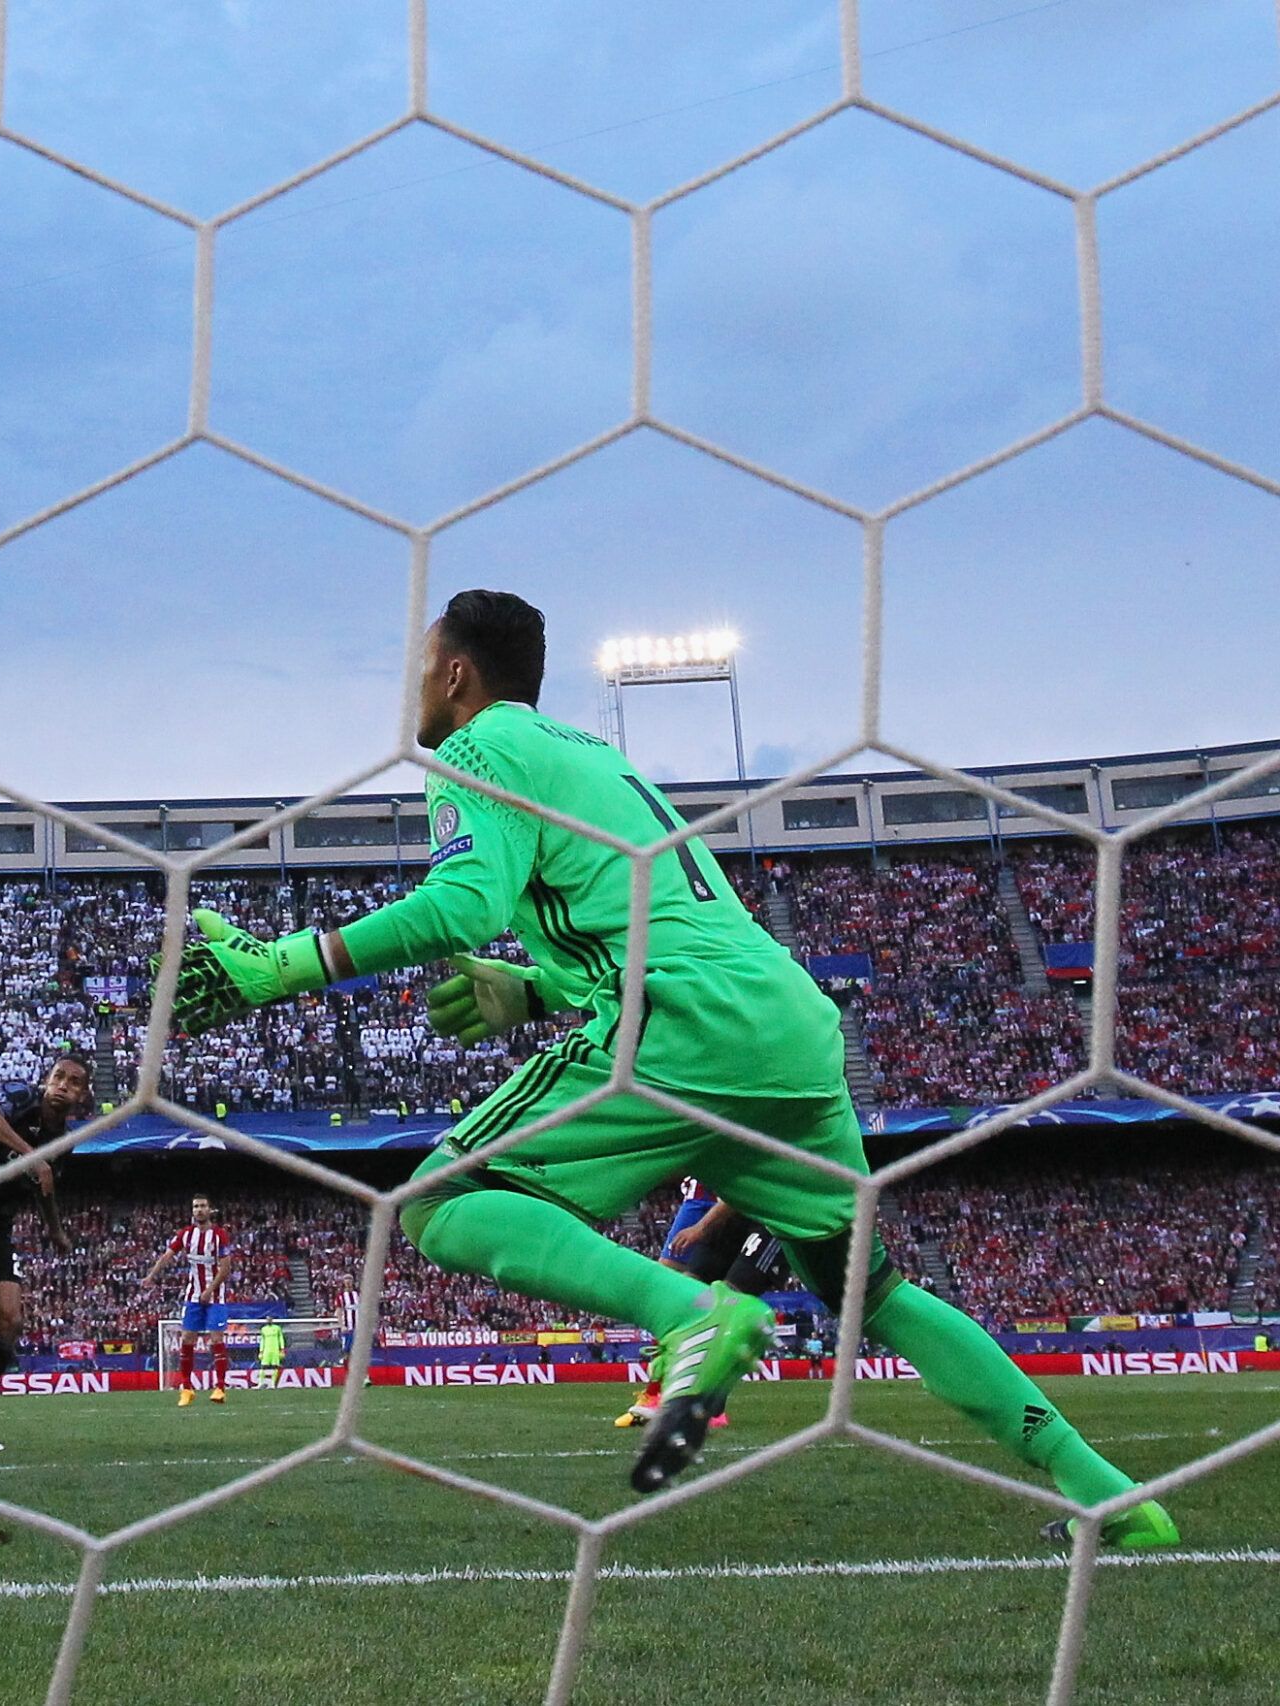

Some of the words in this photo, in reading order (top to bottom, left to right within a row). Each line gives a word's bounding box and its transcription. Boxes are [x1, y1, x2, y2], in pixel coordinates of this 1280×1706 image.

[620, 774, 718, 902] 1
[420, 1331, 472, 1346] YUNCOS
[404, 1363, 556, 1386] NISSAN
[855, 1357, 921, 1380] NIS
[1082, 1351, 1238, 1376] NISSAN
[181, 1367, 332, 1391] NISSAN
